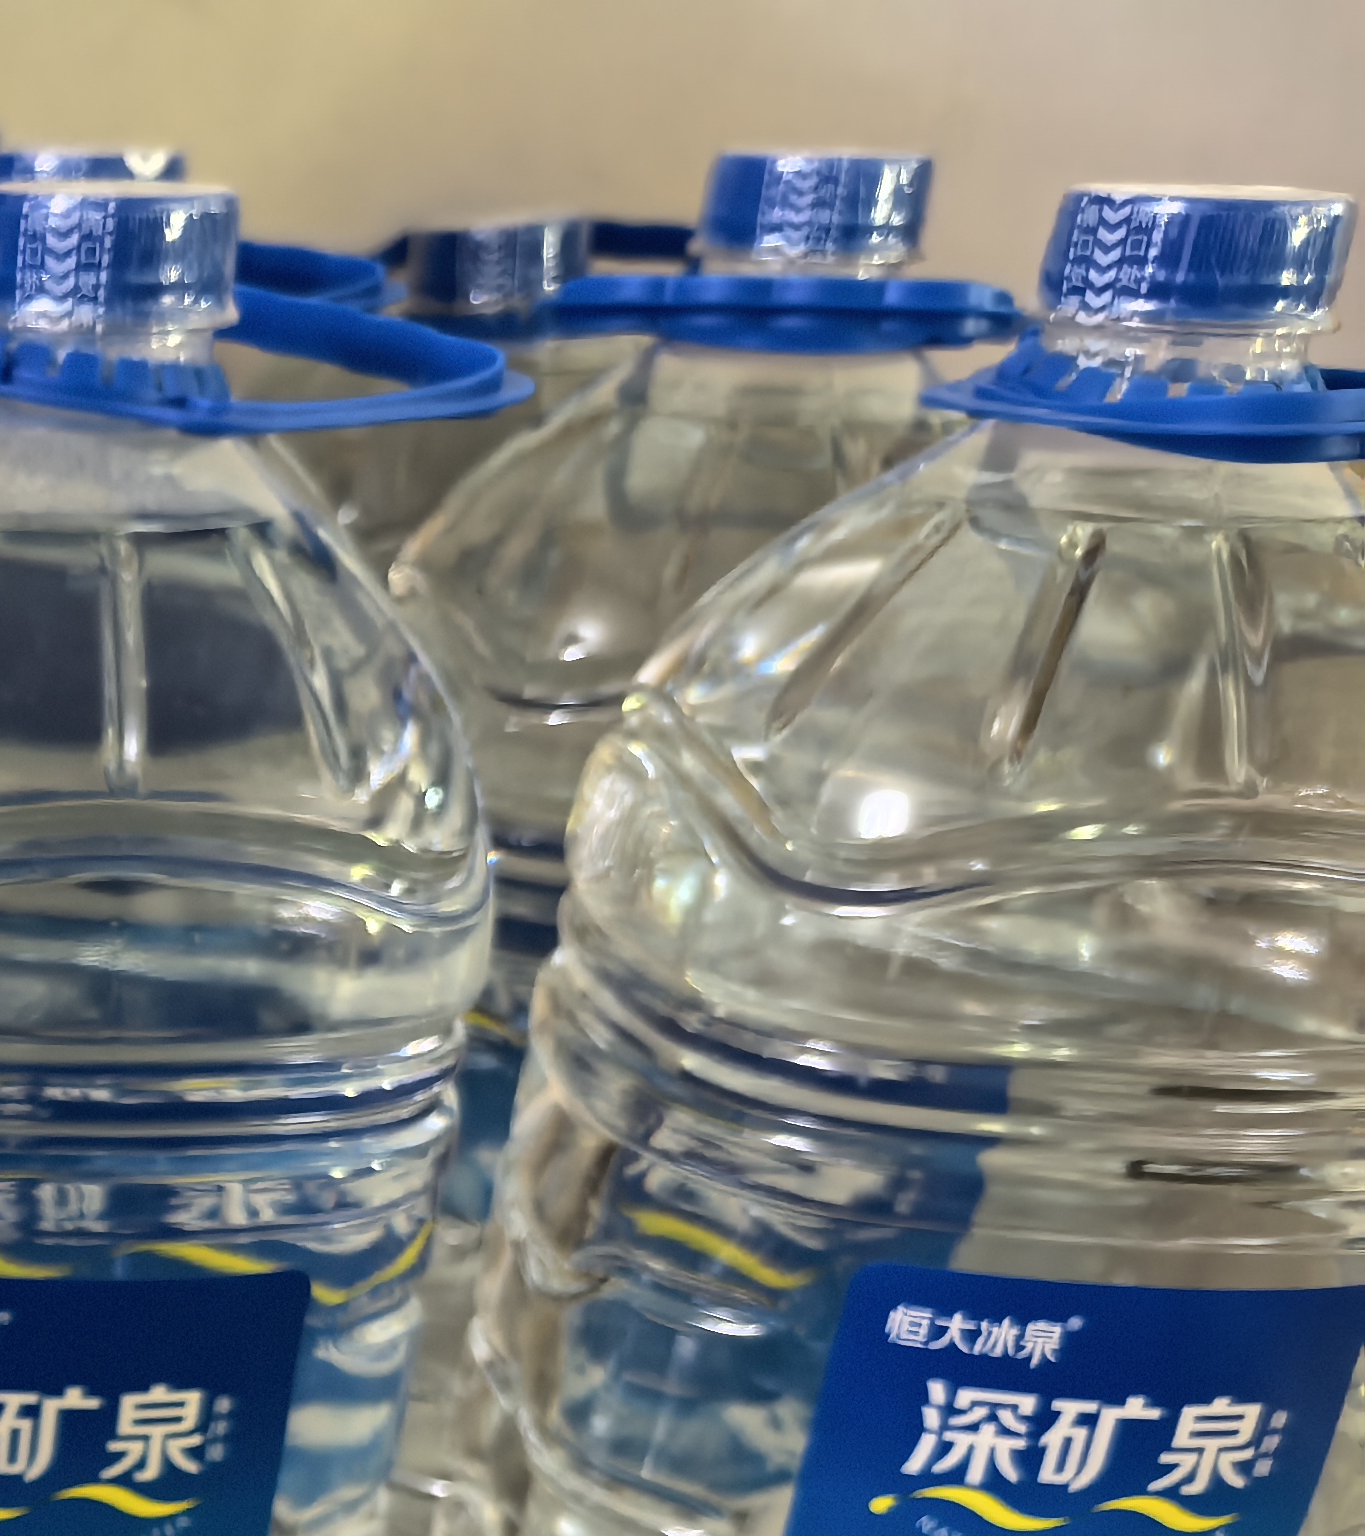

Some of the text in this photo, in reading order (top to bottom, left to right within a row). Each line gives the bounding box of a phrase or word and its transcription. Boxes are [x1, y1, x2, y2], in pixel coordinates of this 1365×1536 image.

[884, 1303, 1064, 1369] 恒大冰泉
[902, 1378, 1263, 1496] 深矿泉
